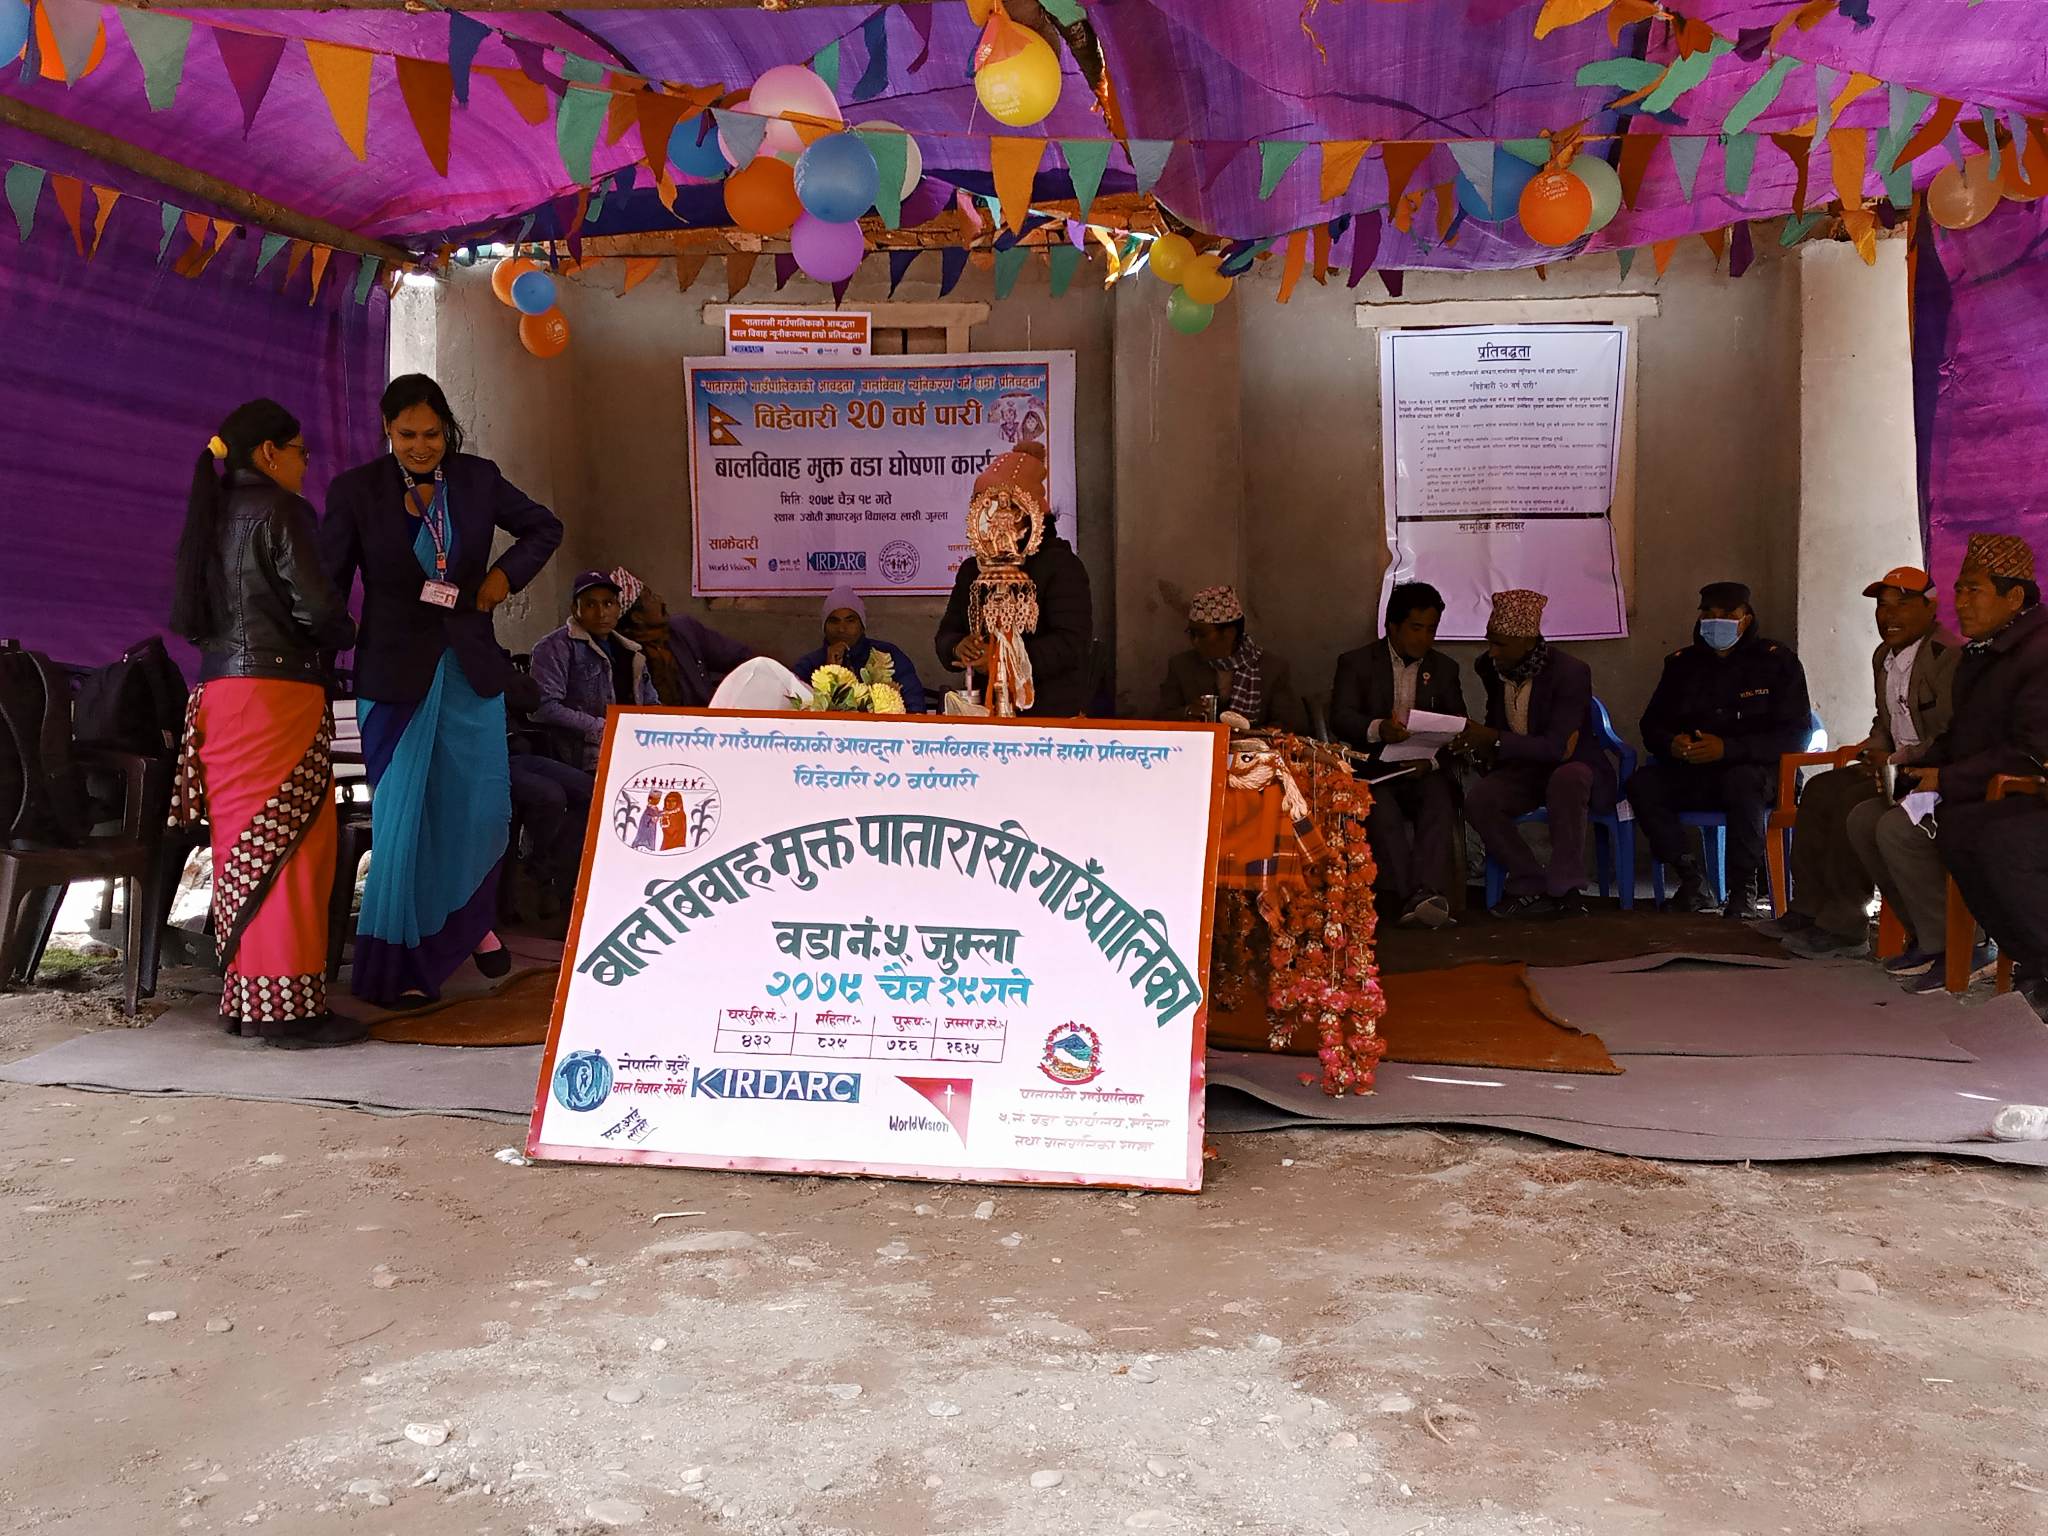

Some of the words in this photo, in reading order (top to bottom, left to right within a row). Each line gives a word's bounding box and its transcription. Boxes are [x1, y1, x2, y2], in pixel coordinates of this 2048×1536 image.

[754, 402, 839, 430] विहेवारी
[892, 401, 927, 427] वर्ष
[934, 398, 984, 425] पारी
[714, 451, 802, 479] बालविवाह
[807, 456, 845, 483] मुक्त
[850, 457, 883, 477] वडा
[888, 450, 946, 476] घोषणा
[875, 490, 893, 505] गते
[708, 535, 759, 550] साझेदारी
[708, 563, 729, 572] World
[729, 563, 751, 572] Vision
[807, 552, 867, 571] KIRDARC
[634, 727, 717, 752] पातारासी
[719, 728, 834, 754] गाउँपालिकाको
[992, 741, 1023, 765] मुक्त
[1023, 737, 1056, 761] गर्ने
[1056, 739, 1095, 763] हाम्रो
[793, 764, 871, 791] विहेवारी
[874, 772, 900, 788] २०
[761, 818, 855, 891] मुक्त
[856, 814, 1039, 894] पातारासी
[1029, 846, 1202, 1028] गाउँपालिका
[771, 921, 848, 960] वडा
[914, 925, 1025, 975] जुम्ला
[765, 970, 864, 1006] २०७९
[874, 962, 936, 1006] चैत्र
[741, 1034, 772, 1049] ४३२
[617, 1052, 663, 1072] नेपाली
[691, 1067, 861, 1103] KIRDARC
